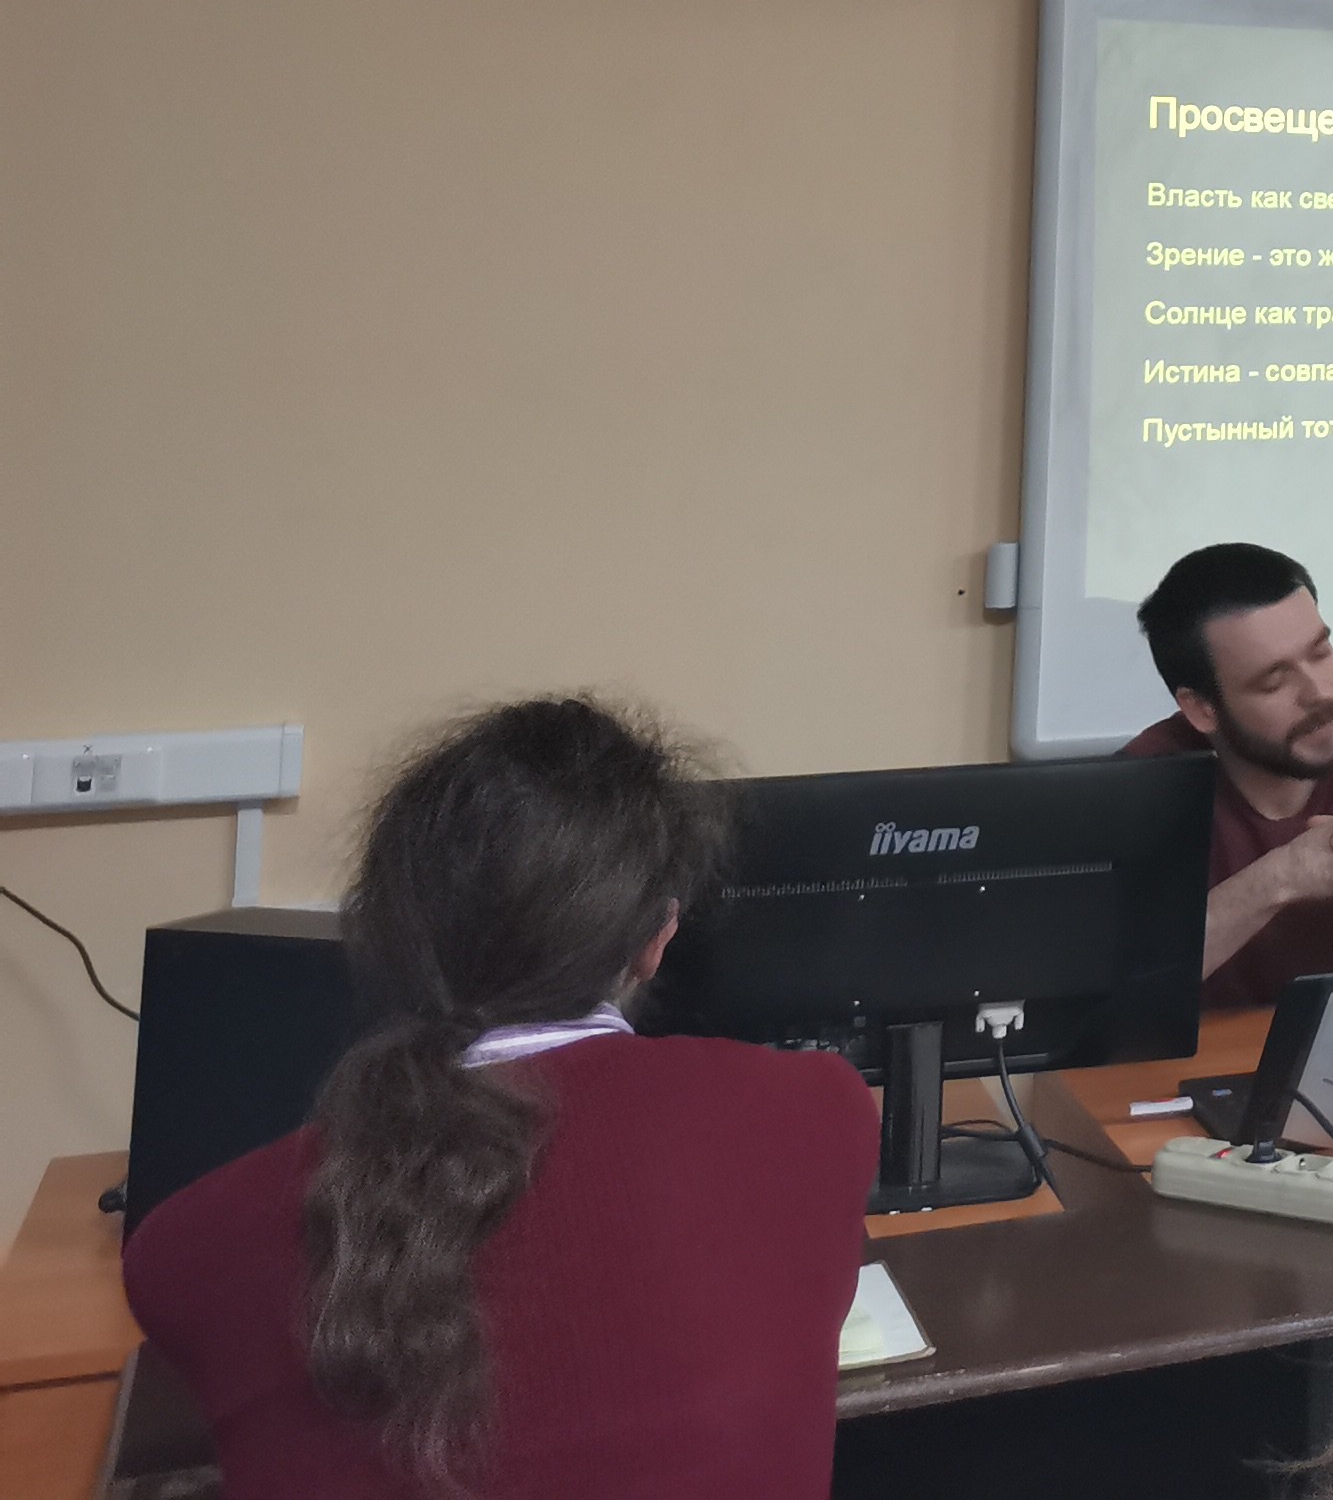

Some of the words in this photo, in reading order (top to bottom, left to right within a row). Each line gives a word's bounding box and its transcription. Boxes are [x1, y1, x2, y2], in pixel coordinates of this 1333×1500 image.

[1147, 182, 1243, 209] Власть
[1251, 188, 1292, 209] как
[1146, 241, 1245, 271] Зрение
[1269, 248, 1312, 268] это
[1145, 300, 1247, 330] Солнце
[1254, 304, 1297, 326] как
[1143, 359, 1241, 384] Истина
[1142, 415, 1295, 448] Пустынный
[869, 821, 980, 856] iiyama
